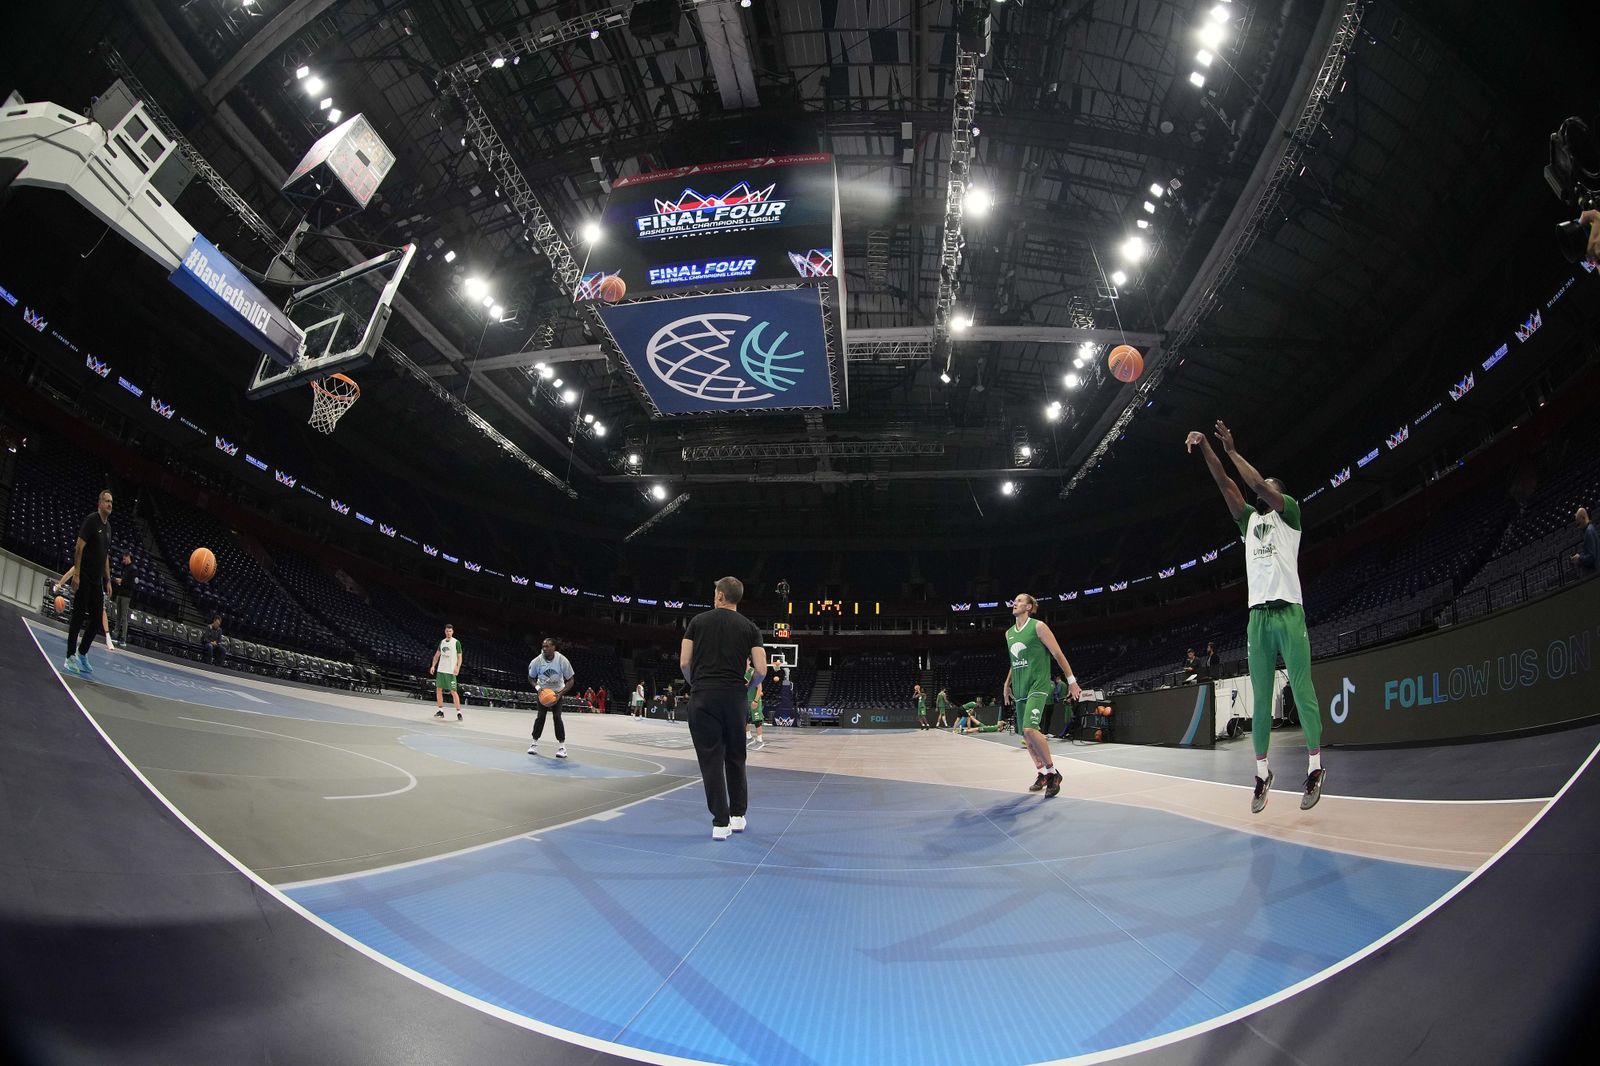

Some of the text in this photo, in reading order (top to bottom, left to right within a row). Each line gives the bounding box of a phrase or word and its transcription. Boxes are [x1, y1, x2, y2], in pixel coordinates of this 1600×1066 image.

[631, 172, 673, 182] ALTABANKA
[703, 162, 748, 171] ALTABANKA
[637, 202, 786, 231] FINAL FOUR
[639, 225, 691, 237] BASKETBALL
[692, 219, 744, 230] CHAMPIONS
[745, 215, 780, 223] LEAGUE
[649, 259, 756, 280] FINAL FOUR
[688, 272, 726, 281] CHAMPIONS
[184, 248, 272, 335] #BasketballCL
[1384, 630, 1592, 710] FOLLOW US ON
